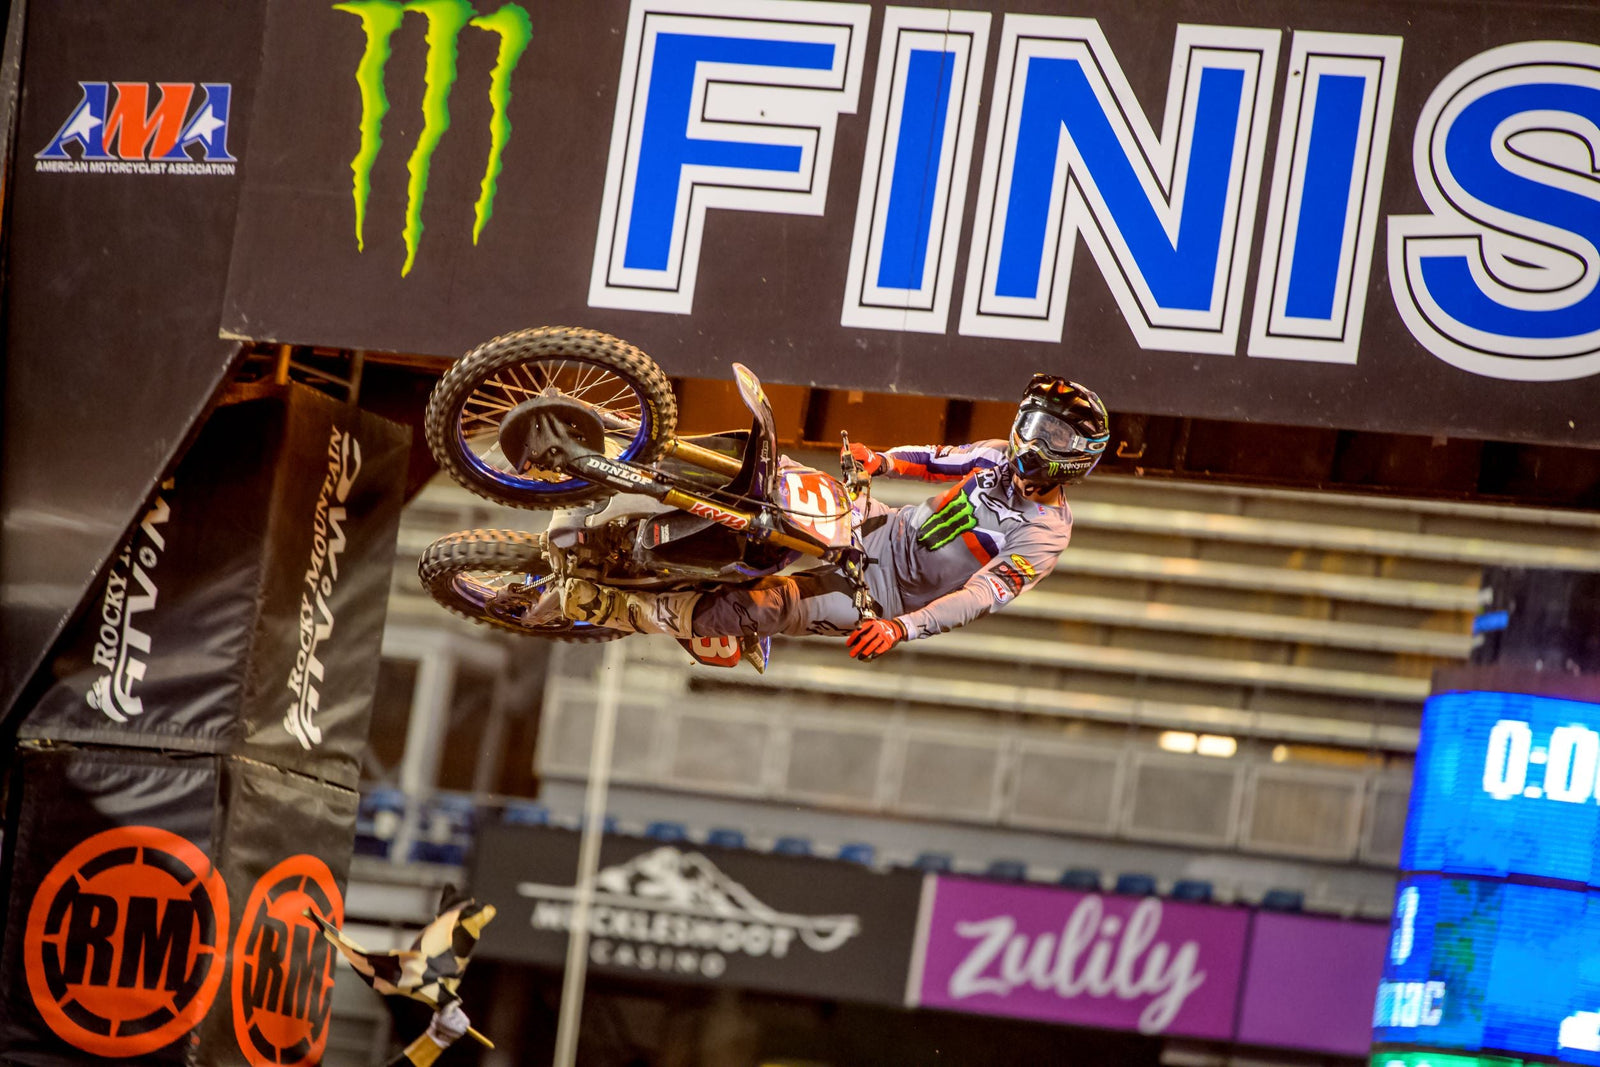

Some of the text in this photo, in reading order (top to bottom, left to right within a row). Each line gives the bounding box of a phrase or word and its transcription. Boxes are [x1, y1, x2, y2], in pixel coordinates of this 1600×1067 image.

[34, 81, 238, 162] AMA
[35, 160, 235, 176] AMERICAN MOTORCYCLIST ASSOCIATION
[588, 0, 1600, 382] FINIS
[647, 399, 660, 440] DUNLOP
[587, 458, 653, 485] DUNLOP
[1060, 462, 1091, 470] MONSTER
[785, 473, 837, 541] 3
[287, 424, 343, 700] ROCKY MOUNTAIN
[92, 568, 128, 671] ROCKY
[1483, 719, 1600, 806] 0:0
[63, 892, 196, 992] RM
[589, 939, 727, 979] CASINO
